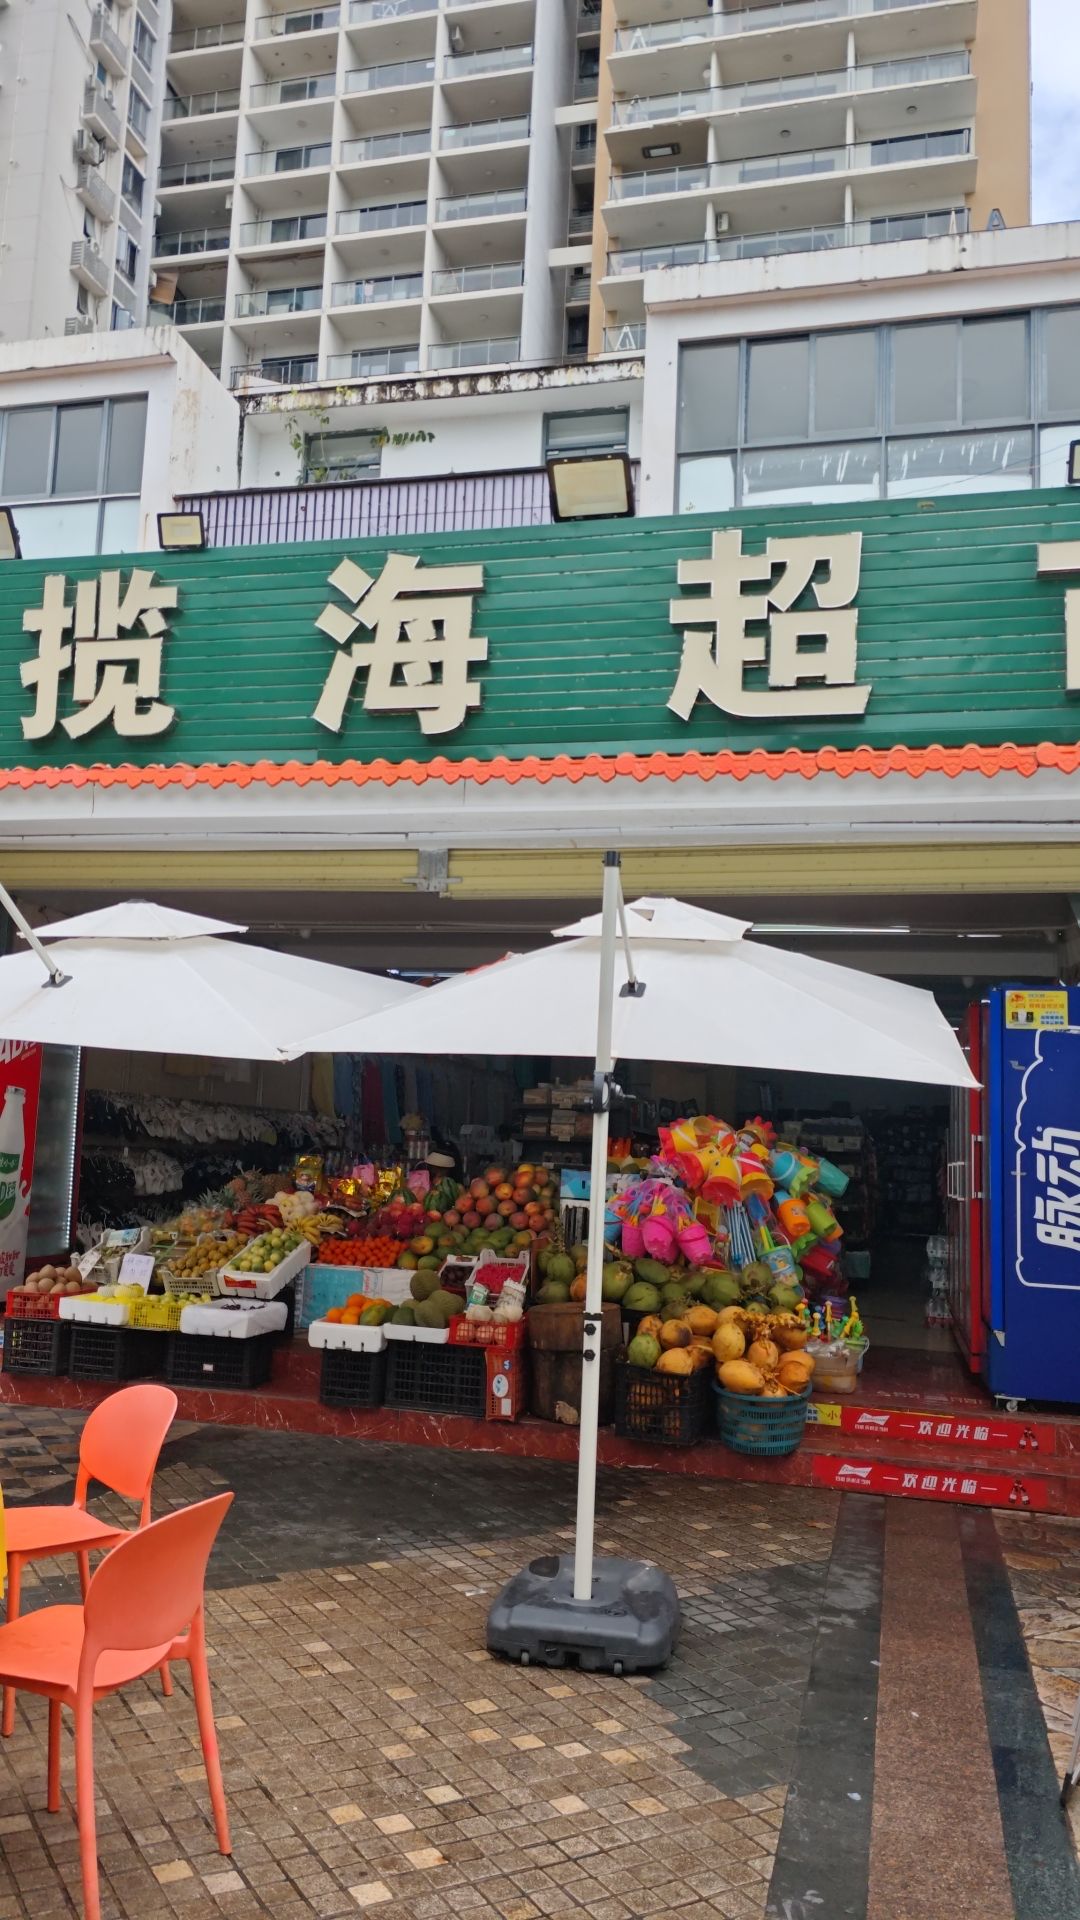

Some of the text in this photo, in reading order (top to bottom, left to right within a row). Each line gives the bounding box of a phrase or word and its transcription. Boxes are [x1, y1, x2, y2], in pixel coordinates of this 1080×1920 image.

[20, 529, 1080, 740] 揽海超
[918, 1421, 990, 1441] 欢迎光临
[902, 1473, 978, 1495] 欢迎光临
